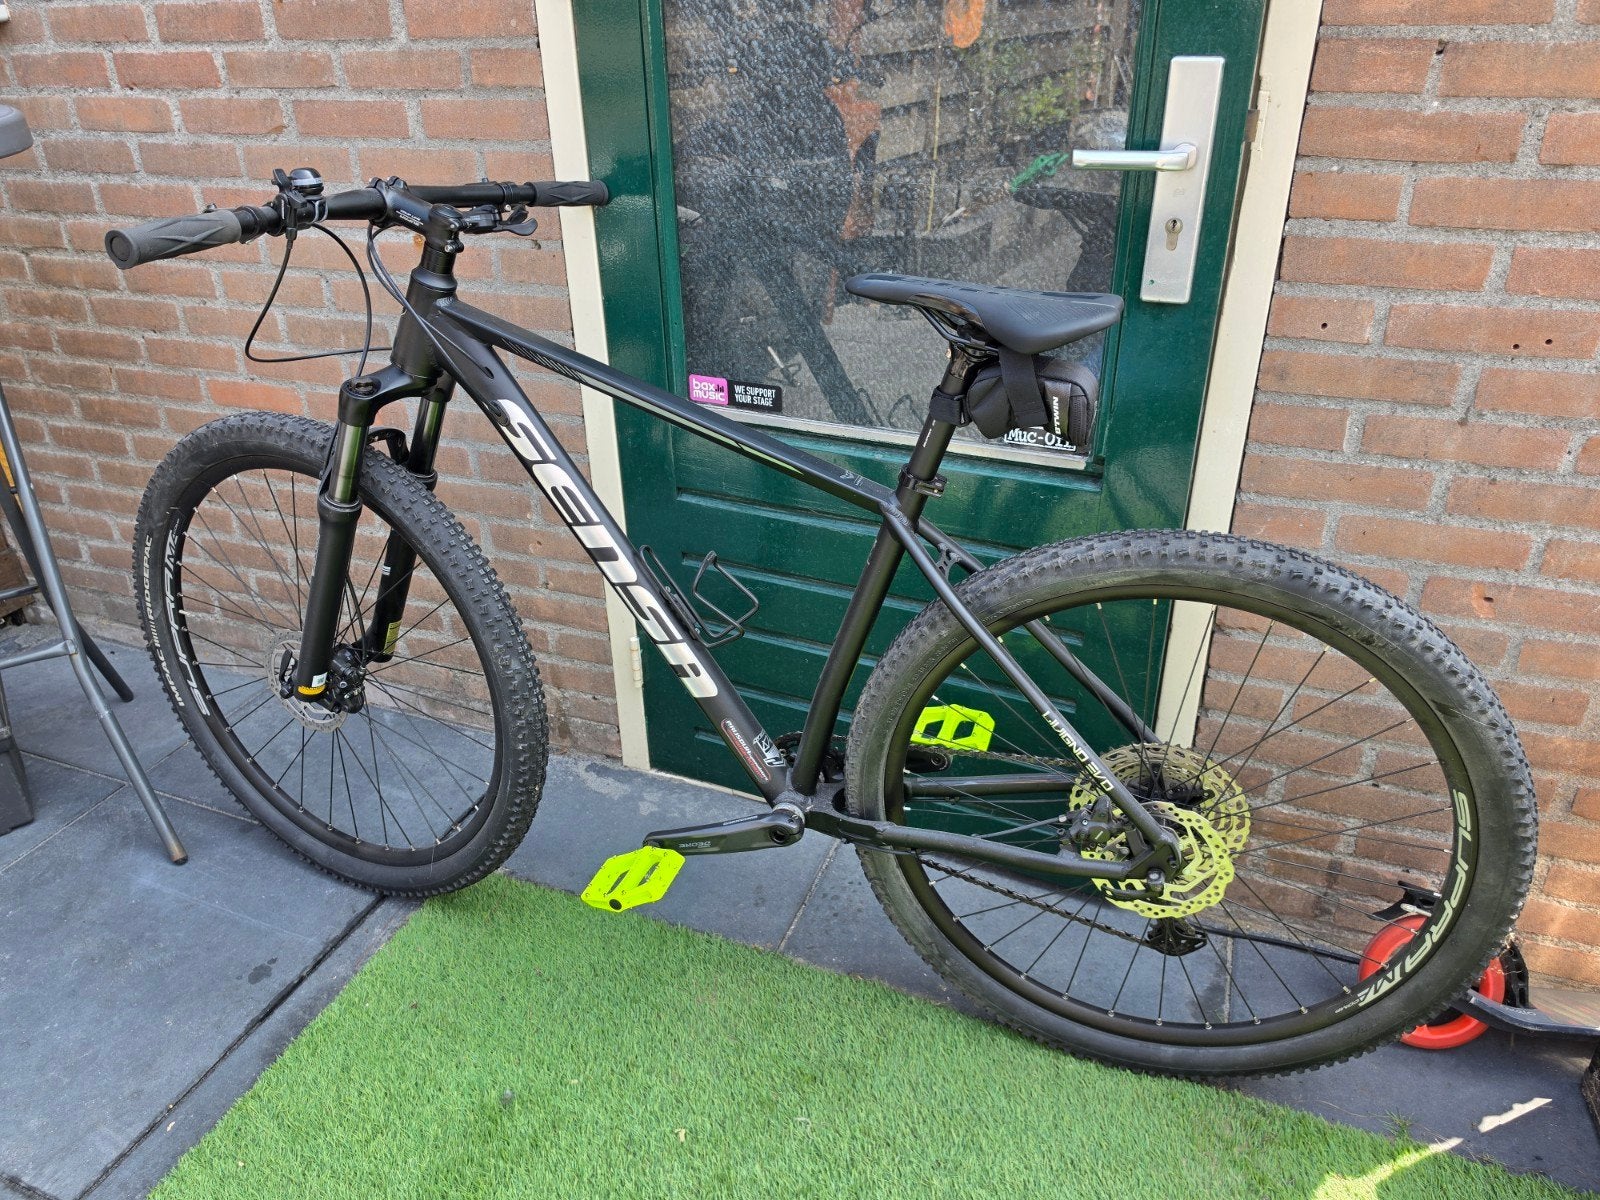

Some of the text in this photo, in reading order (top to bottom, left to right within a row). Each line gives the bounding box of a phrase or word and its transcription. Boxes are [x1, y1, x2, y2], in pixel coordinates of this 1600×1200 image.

[692, 378, 715, 391] bax
[734, 385, 776, 397] WE SUPPORT
[735, 394, 774, 407] YOUR STAGE
[485, 398, 719, 698] SENSA
[143, 535, 186, 707] IMPAC RIDGEPAC
[1042, 711, 1114, 791] LIVIGNO EVO
